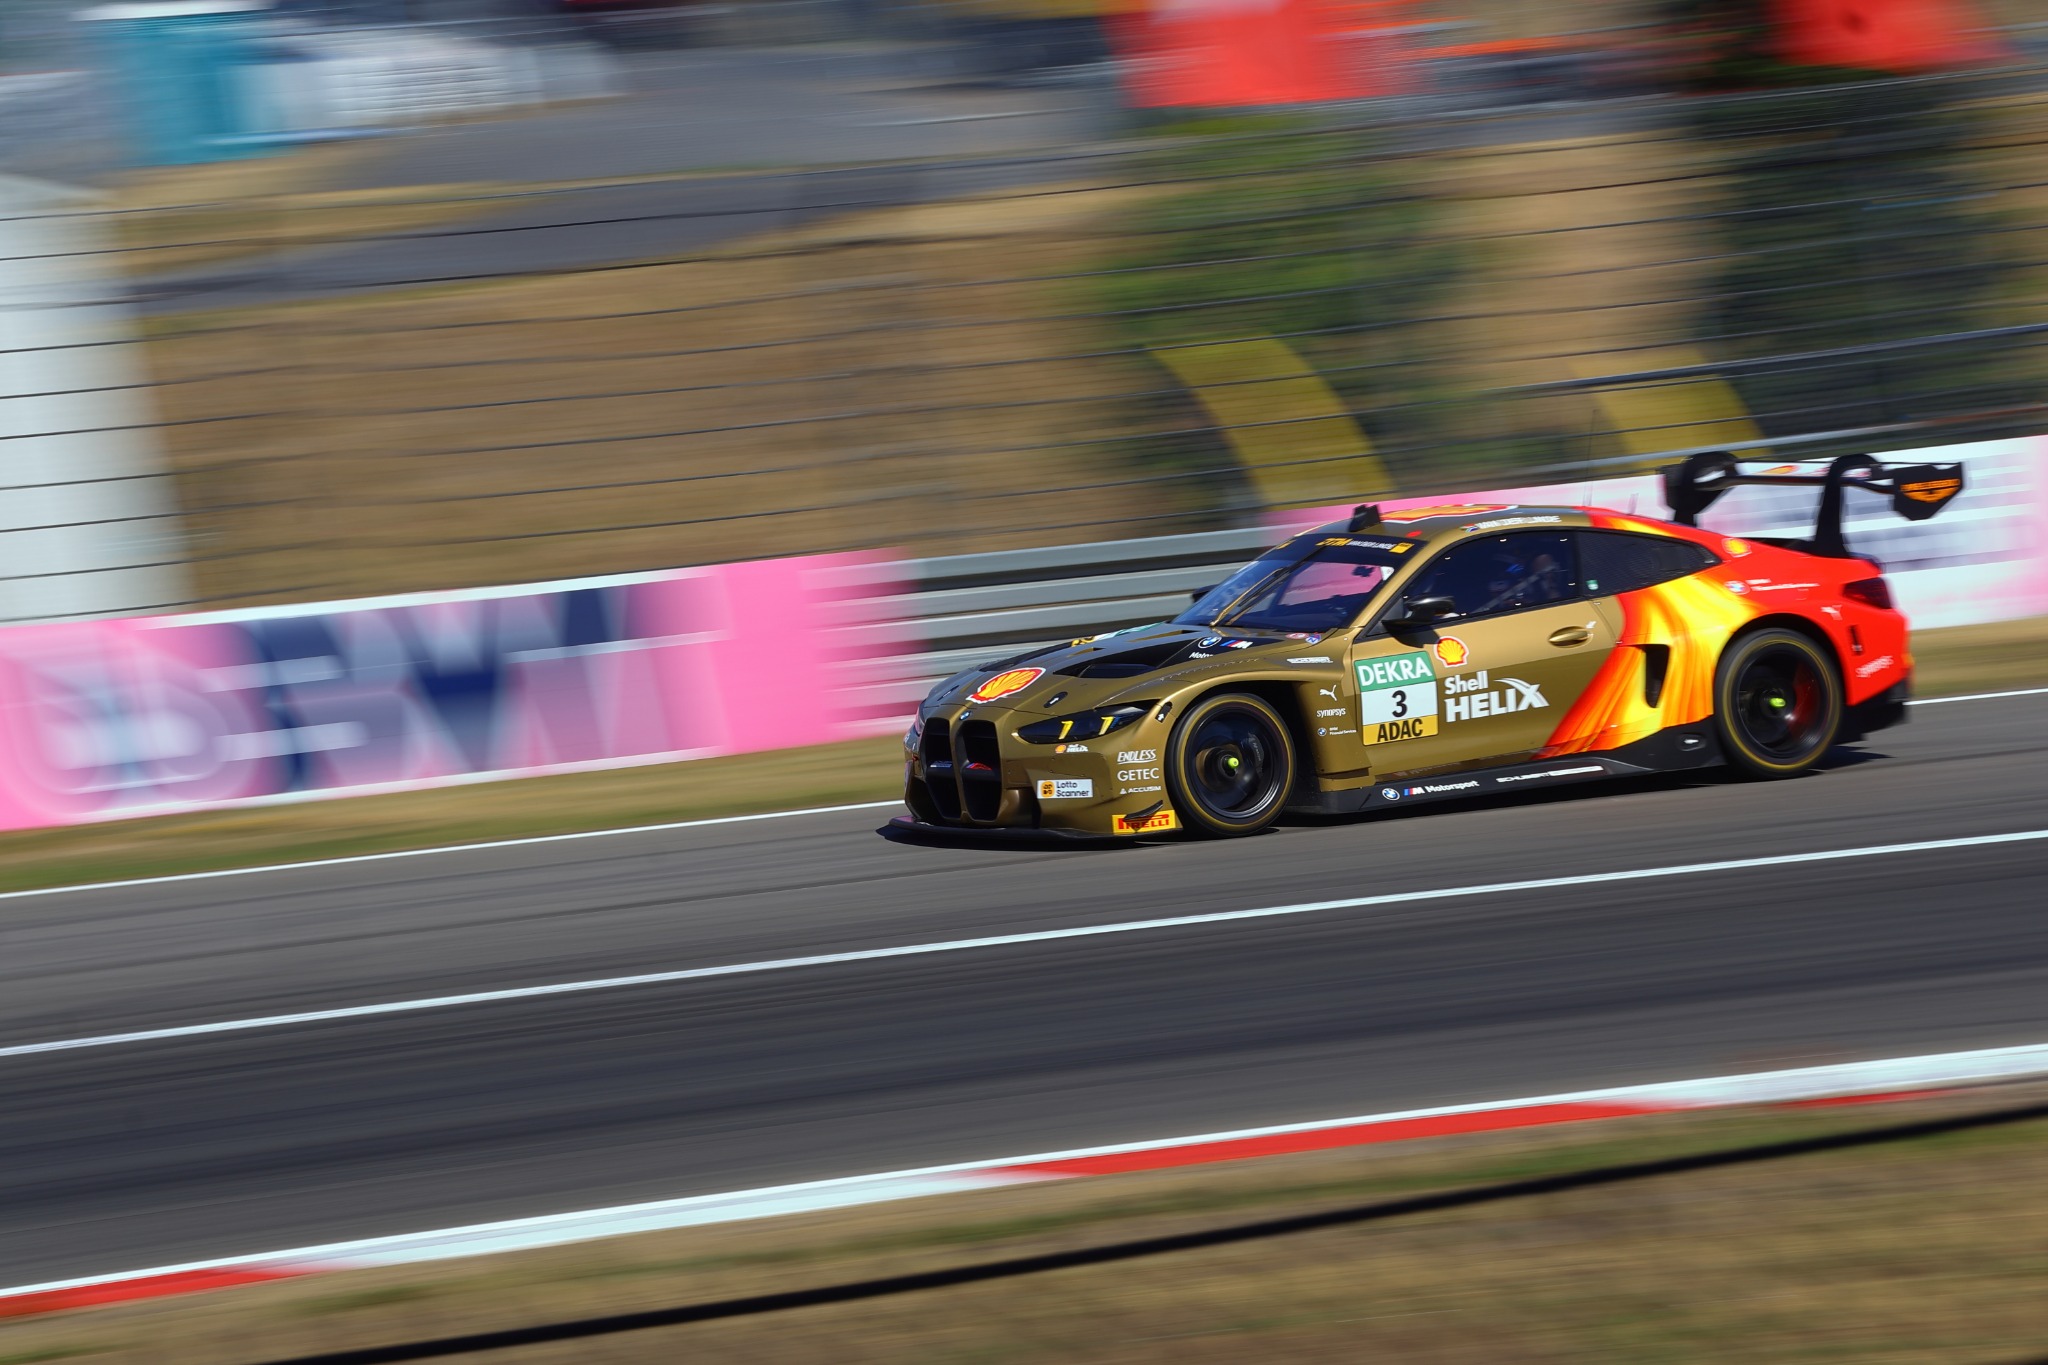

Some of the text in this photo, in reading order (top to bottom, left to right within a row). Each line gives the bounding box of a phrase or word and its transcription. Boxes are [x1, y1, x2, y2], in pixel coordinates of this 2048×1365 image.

[1357, 657, 1433, 687] DEKRA
[1444, 670, 1488, 695] Shell
[1391, 690, 1408, 718] 3
[1444, 677, 1550, 722] HELIX
[1377, 718, 1423, 743] ADAC
[1117, 749, 1157, 763] ENDLESS
[1117, 767, 1160, 782] GETEC
[1056, 781, 1078, 790] Lotto
[1056, 789, 1090, 798] Scanner
[1425, 780, 1480, 793] Motorsport
